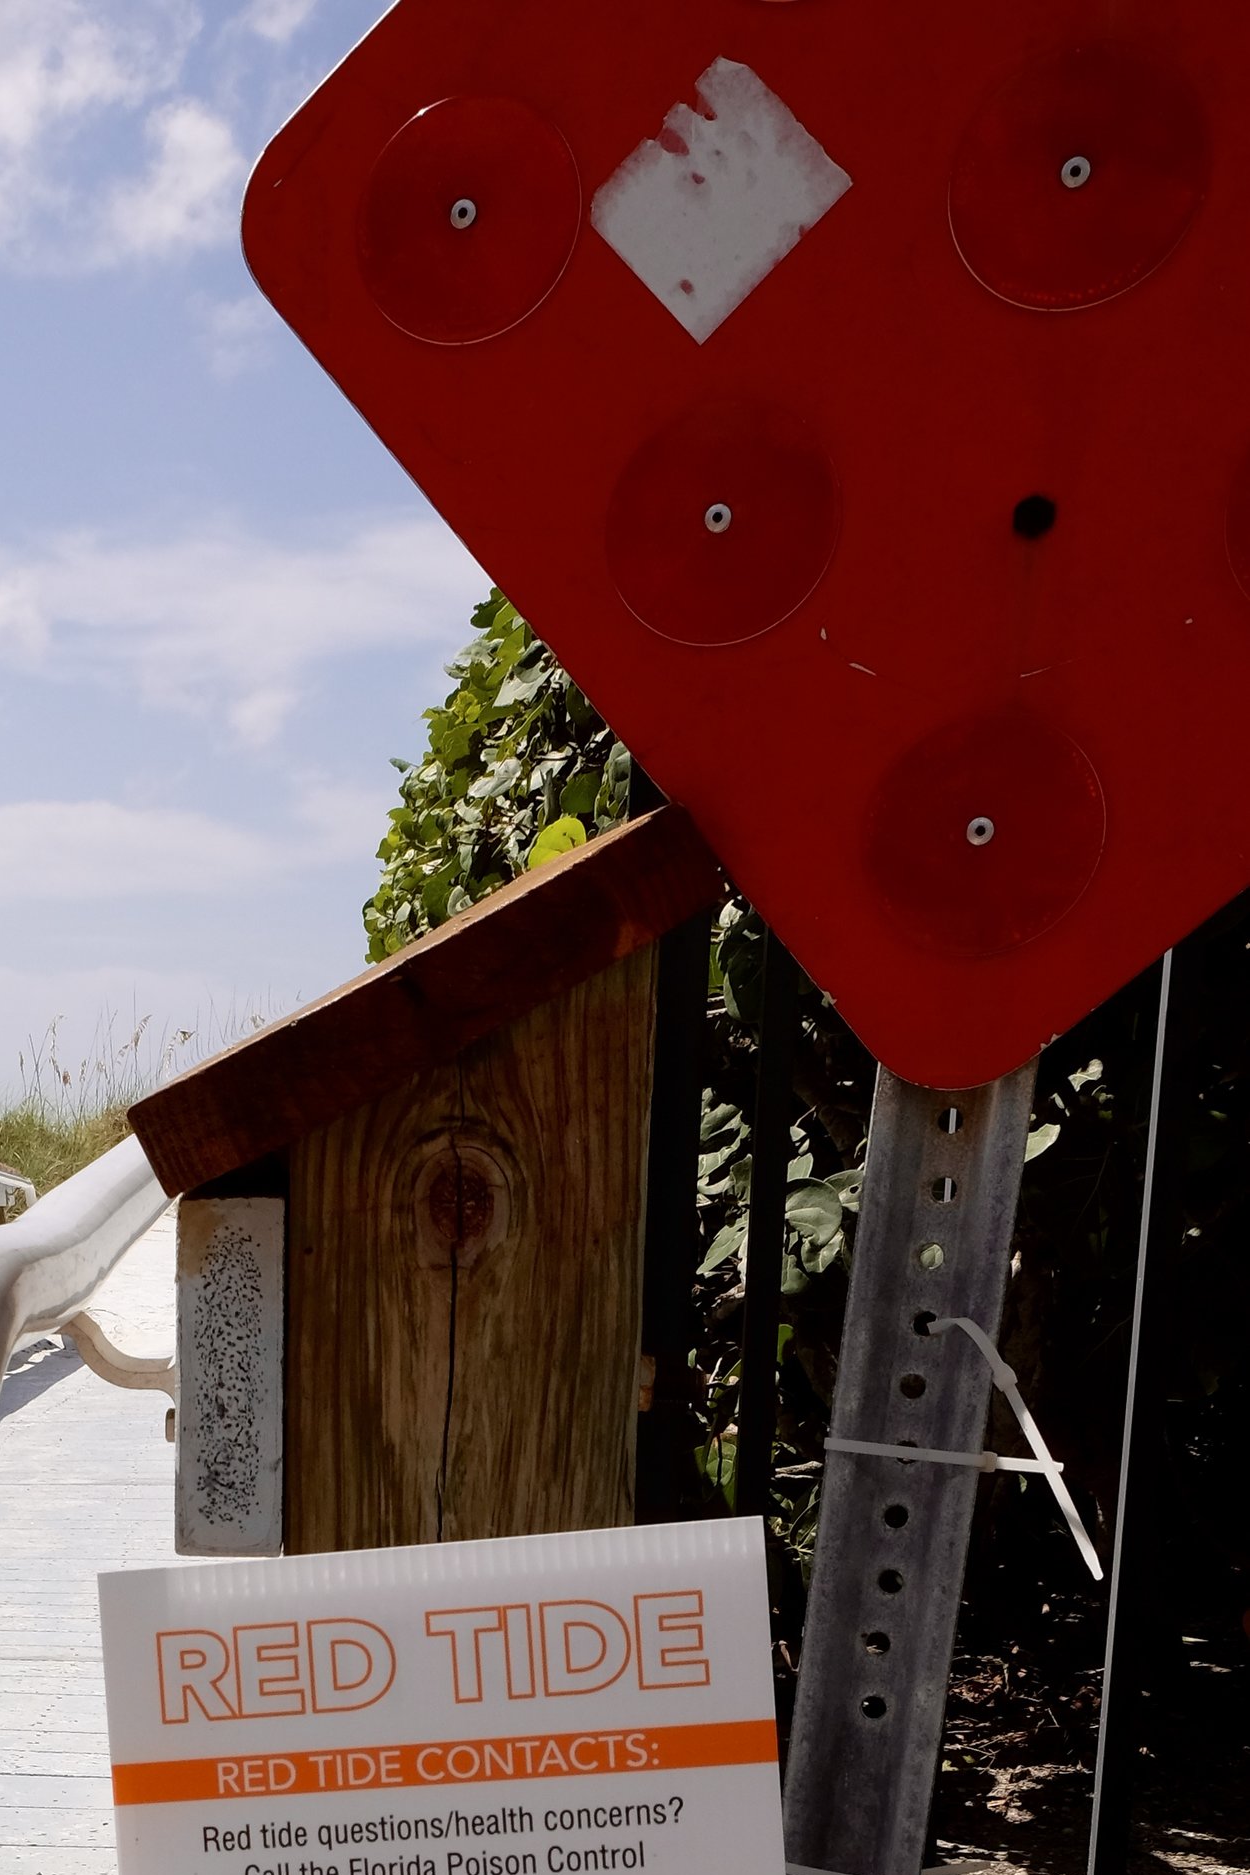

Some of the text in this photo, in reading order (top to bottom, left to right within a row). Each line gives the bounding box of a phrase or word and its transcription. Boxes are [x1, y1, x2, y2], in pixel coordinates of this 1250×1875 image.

[156, 1590, 710, 1725] RED TIDE
[219, 1733, 660, 1792] RED TIDE CONTACTS:
[203, 1796, 683, 1852] Red tide questions/health concerns?
[548, 1841, 644, 1873] Control
